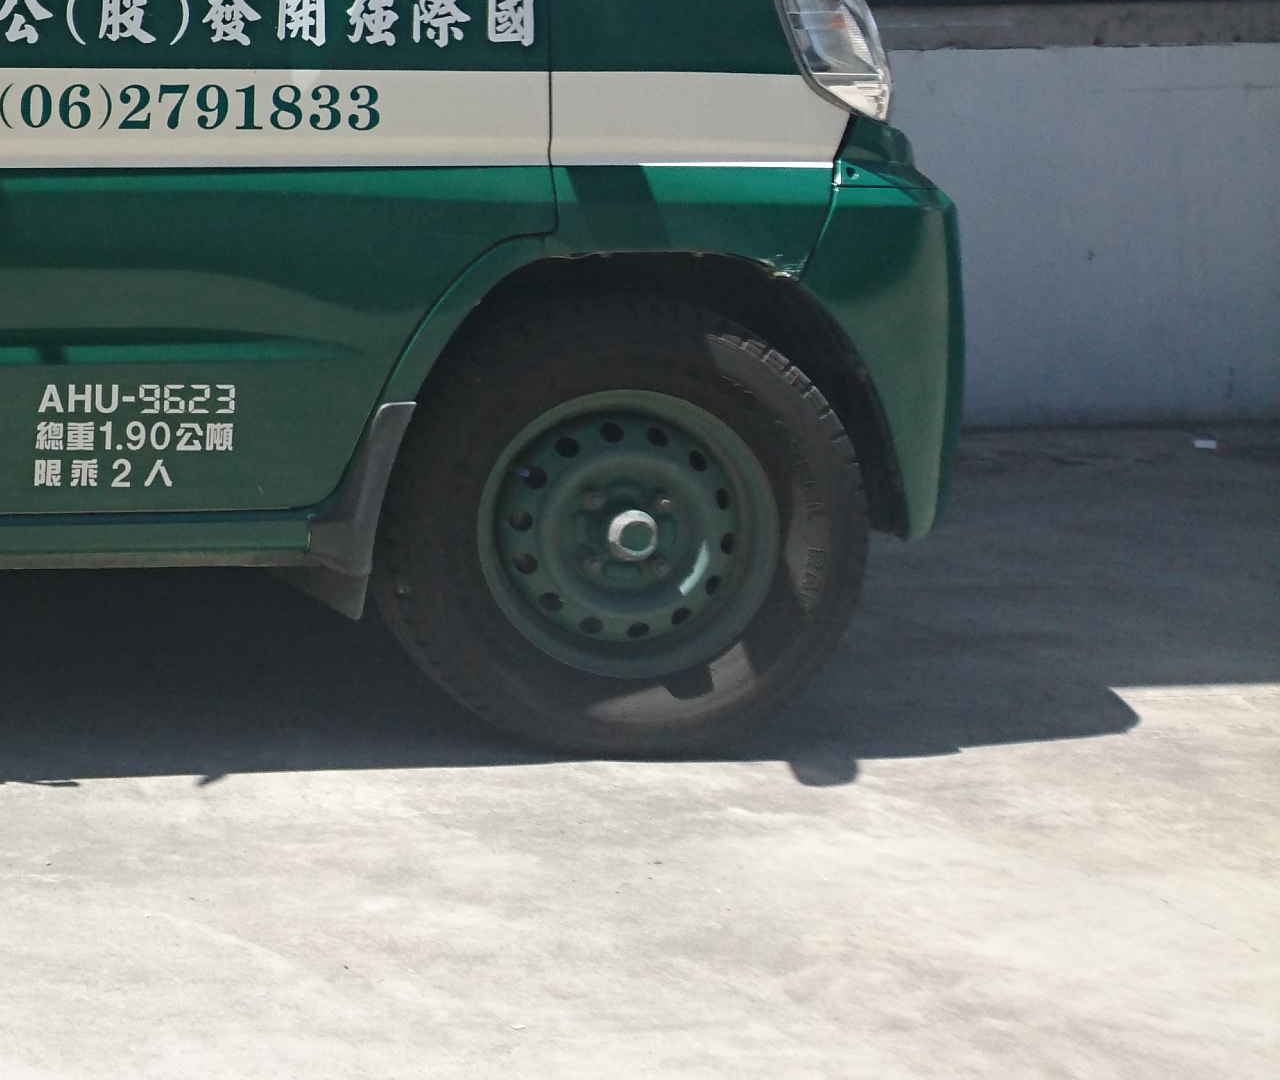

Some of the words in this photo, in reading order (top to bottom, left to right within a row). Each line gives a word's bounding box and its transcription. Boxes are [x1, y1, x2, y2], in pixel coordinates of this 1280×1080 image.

[37, 384, 236, 414] AHU-9623
[35, 421, 234, 451] 總重1.90公噸
